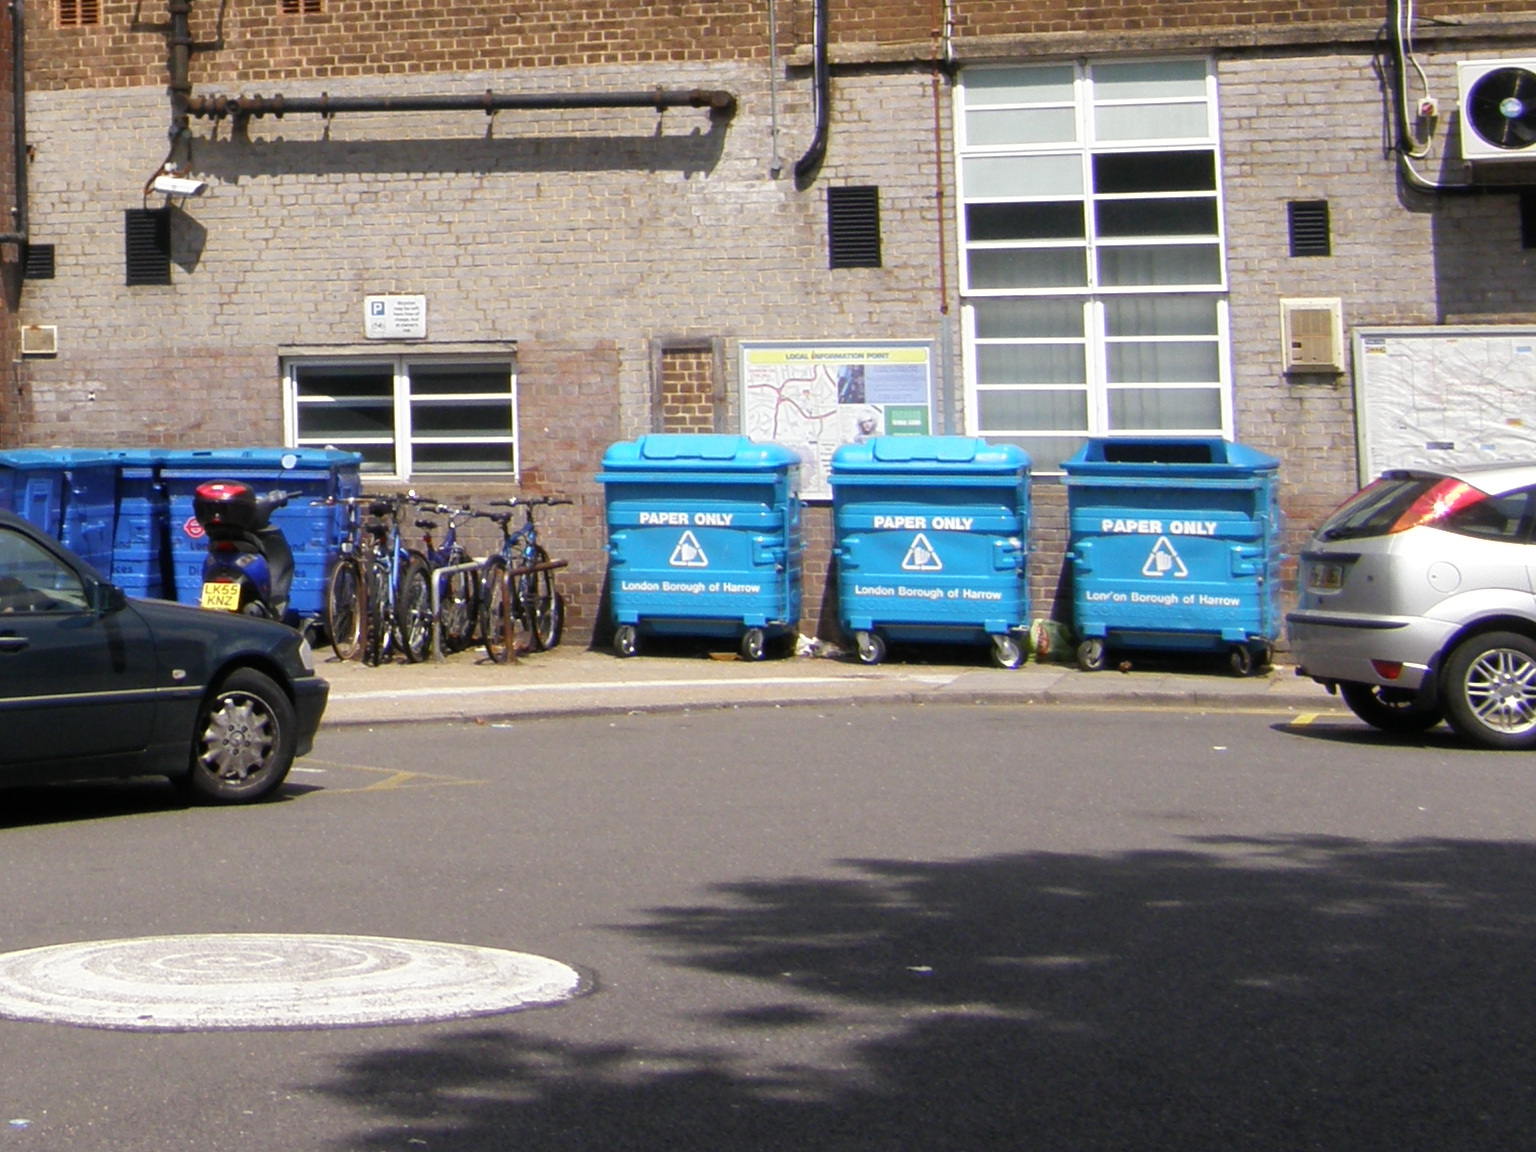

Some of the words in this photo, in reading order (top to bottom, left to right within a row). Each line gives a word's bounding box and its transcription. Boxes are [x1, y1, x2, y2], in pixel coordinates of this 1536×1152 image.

[639, 512, 689, 525] PAPER
[694, 513, 733, 526] ONLY
[874, 516, 926, 529] PAPER
[932, 517, 973, 530] ONLY
[1102, 519, 1162, 534] PAPER
[1170, 521, 1217, 535] ONLY
[205, 584, 238, 595] LK55
[622, 580, 659, 591] London
[662, 581, 705, 594] Borough
[709, 582, 720, 592] of
[723, 582, 761, 593] Harrow
[855, 584, 894, 596] London
[898, 586, 944, 600] Borough
[947, 587, 959, 599] of
[962, 588, 1002, 600] Harrow
[207, 595, 234, 607] KNZ
[1131, 591, 1178, 606] Borough
[1183, 593, 1195, 604] of
[1199, 594, 1240, 606] Harrow
